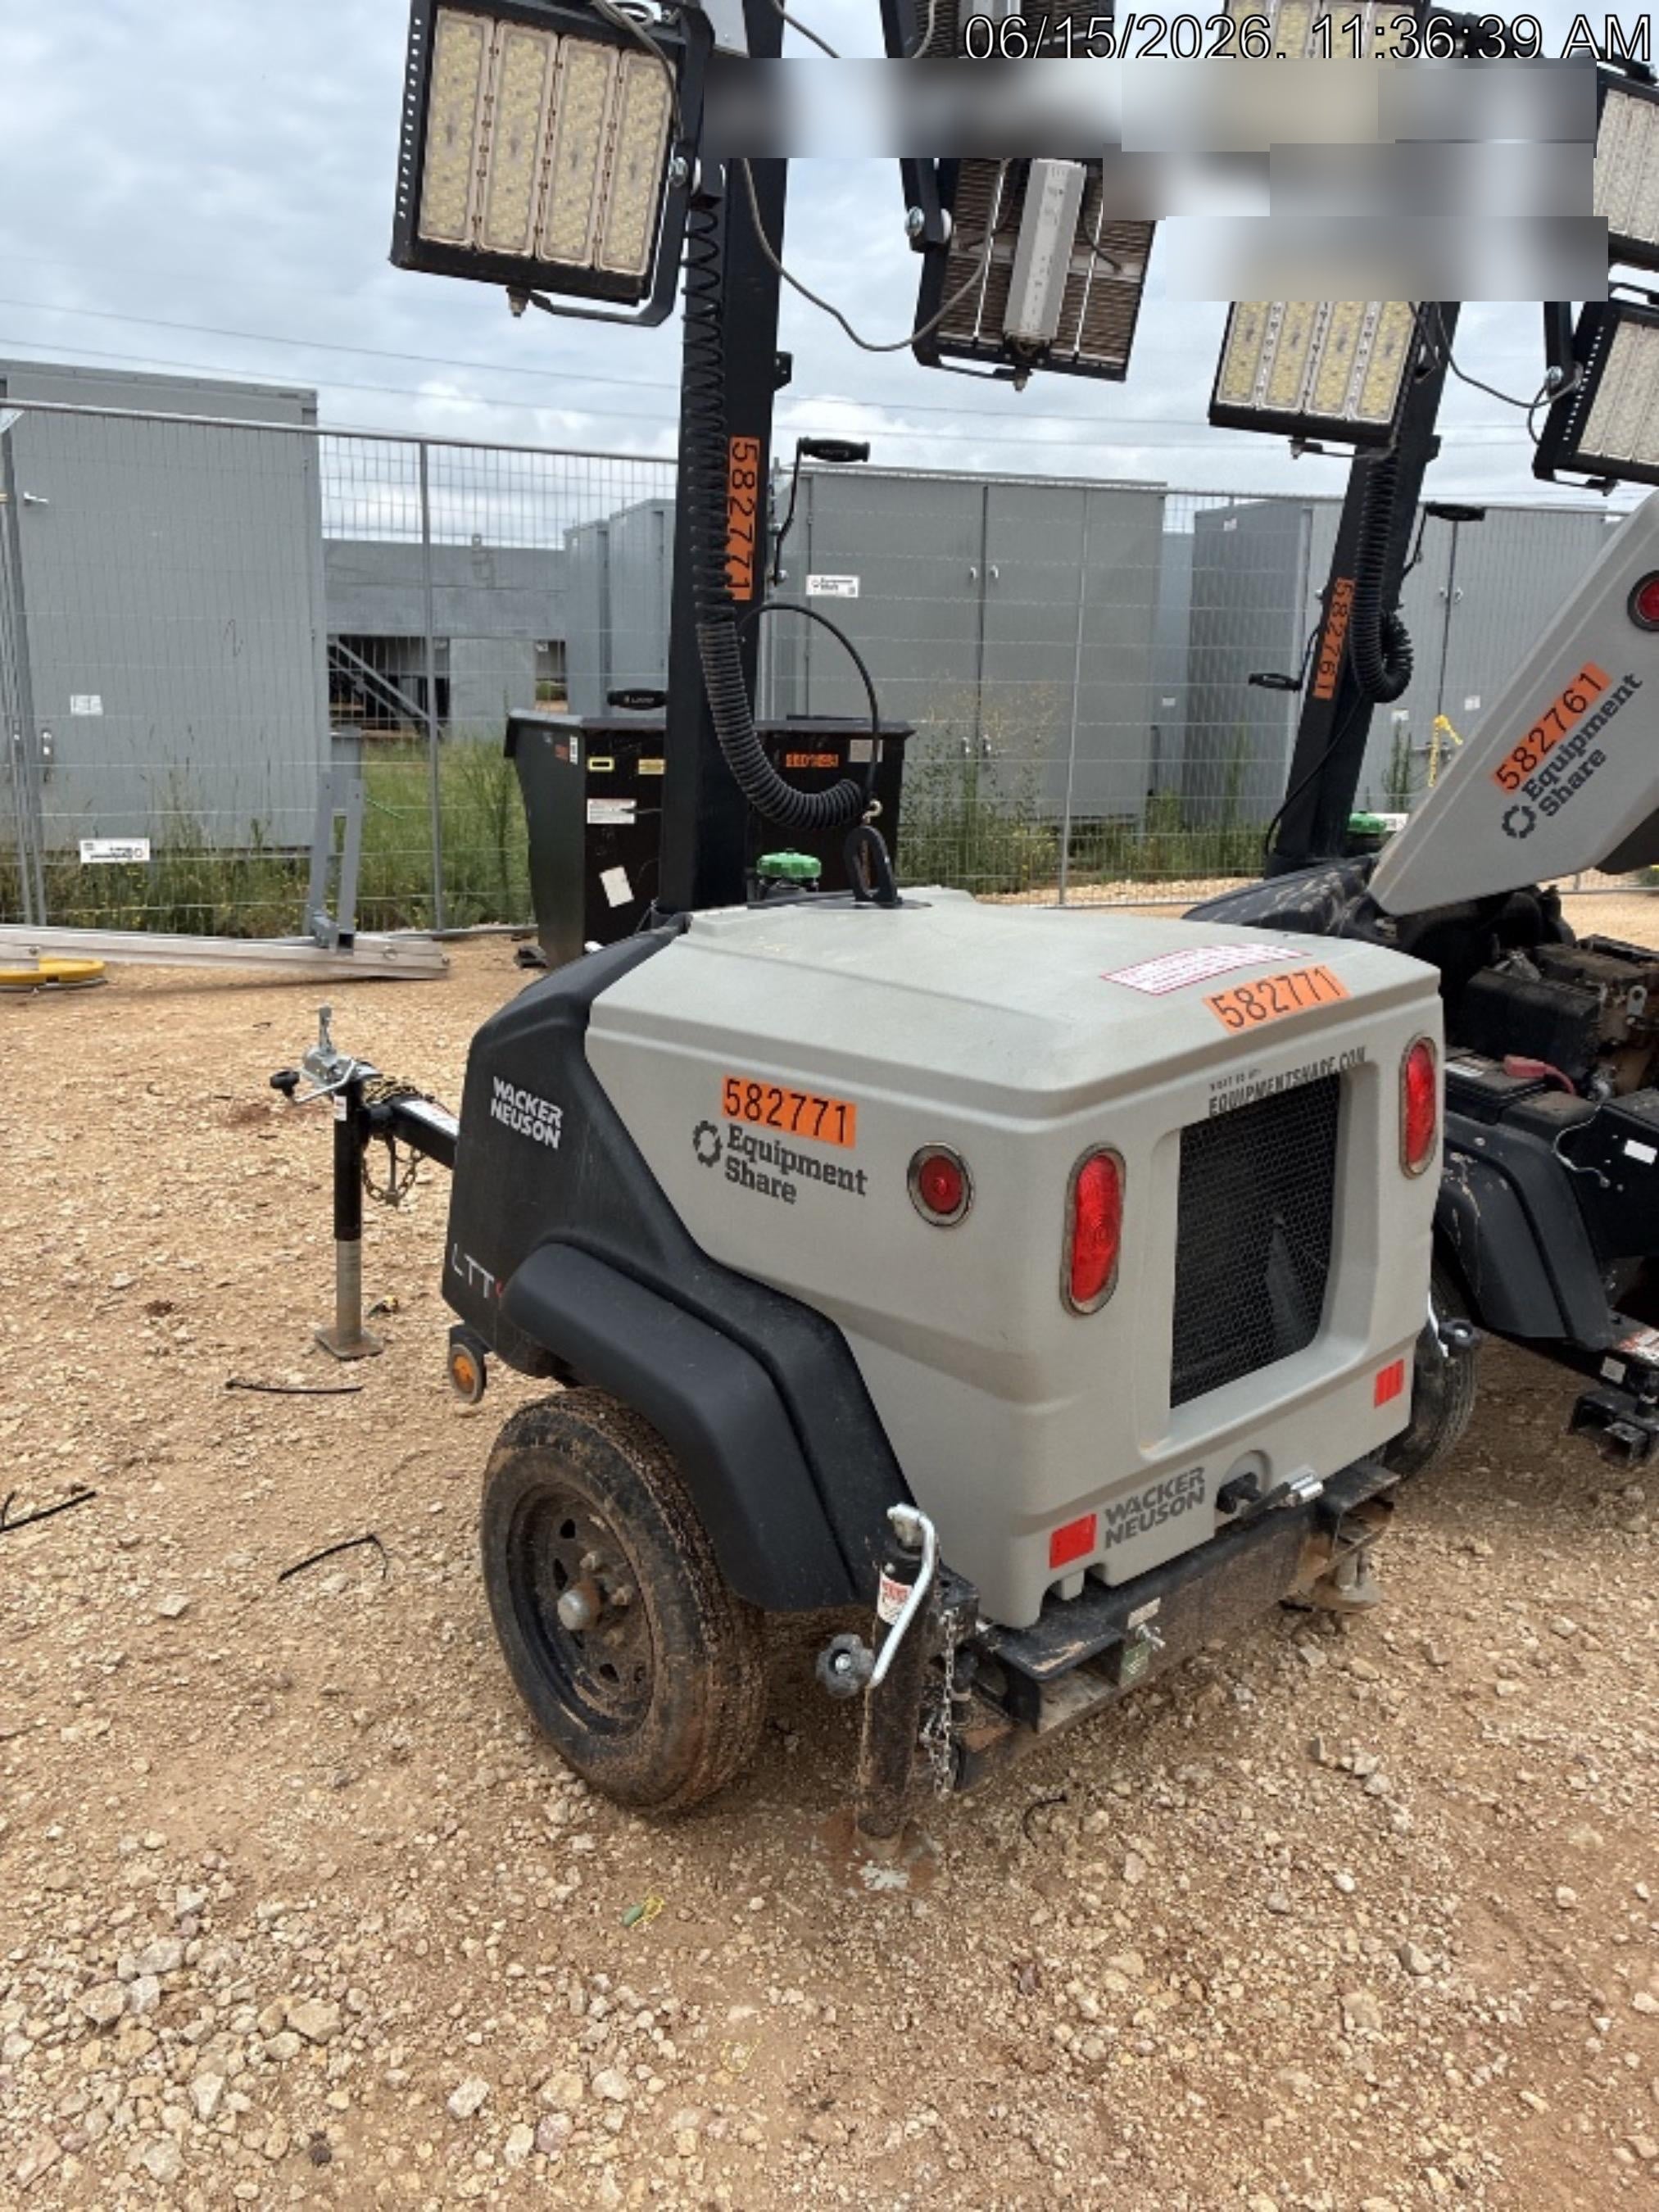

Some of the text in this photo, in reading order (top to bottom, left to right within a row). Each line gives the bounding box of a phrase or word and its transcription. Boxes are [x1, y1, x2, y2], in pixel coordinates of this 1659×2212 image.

[728, 442, 759, 588] 582771
[1496, 673, 1602, 790] 582761
[1521, 673, 1643, 801] Equipment
[1539, 749, 1607, 817] Share
[1211, 966, 1341, 1029] 582771
[491, 1098, 561, 1149] NEUSON
[493, 1076, 564, 1129] WACKER
[724, 1078, 846, 1144] 582771
[724, 1154, 797, 1205] Share
[727, 1123, 868, 1197] Equipment
[1104, 1466, 1205, 1525] WACKER
[1104, 1487, 1205, 1550] NEUSON
